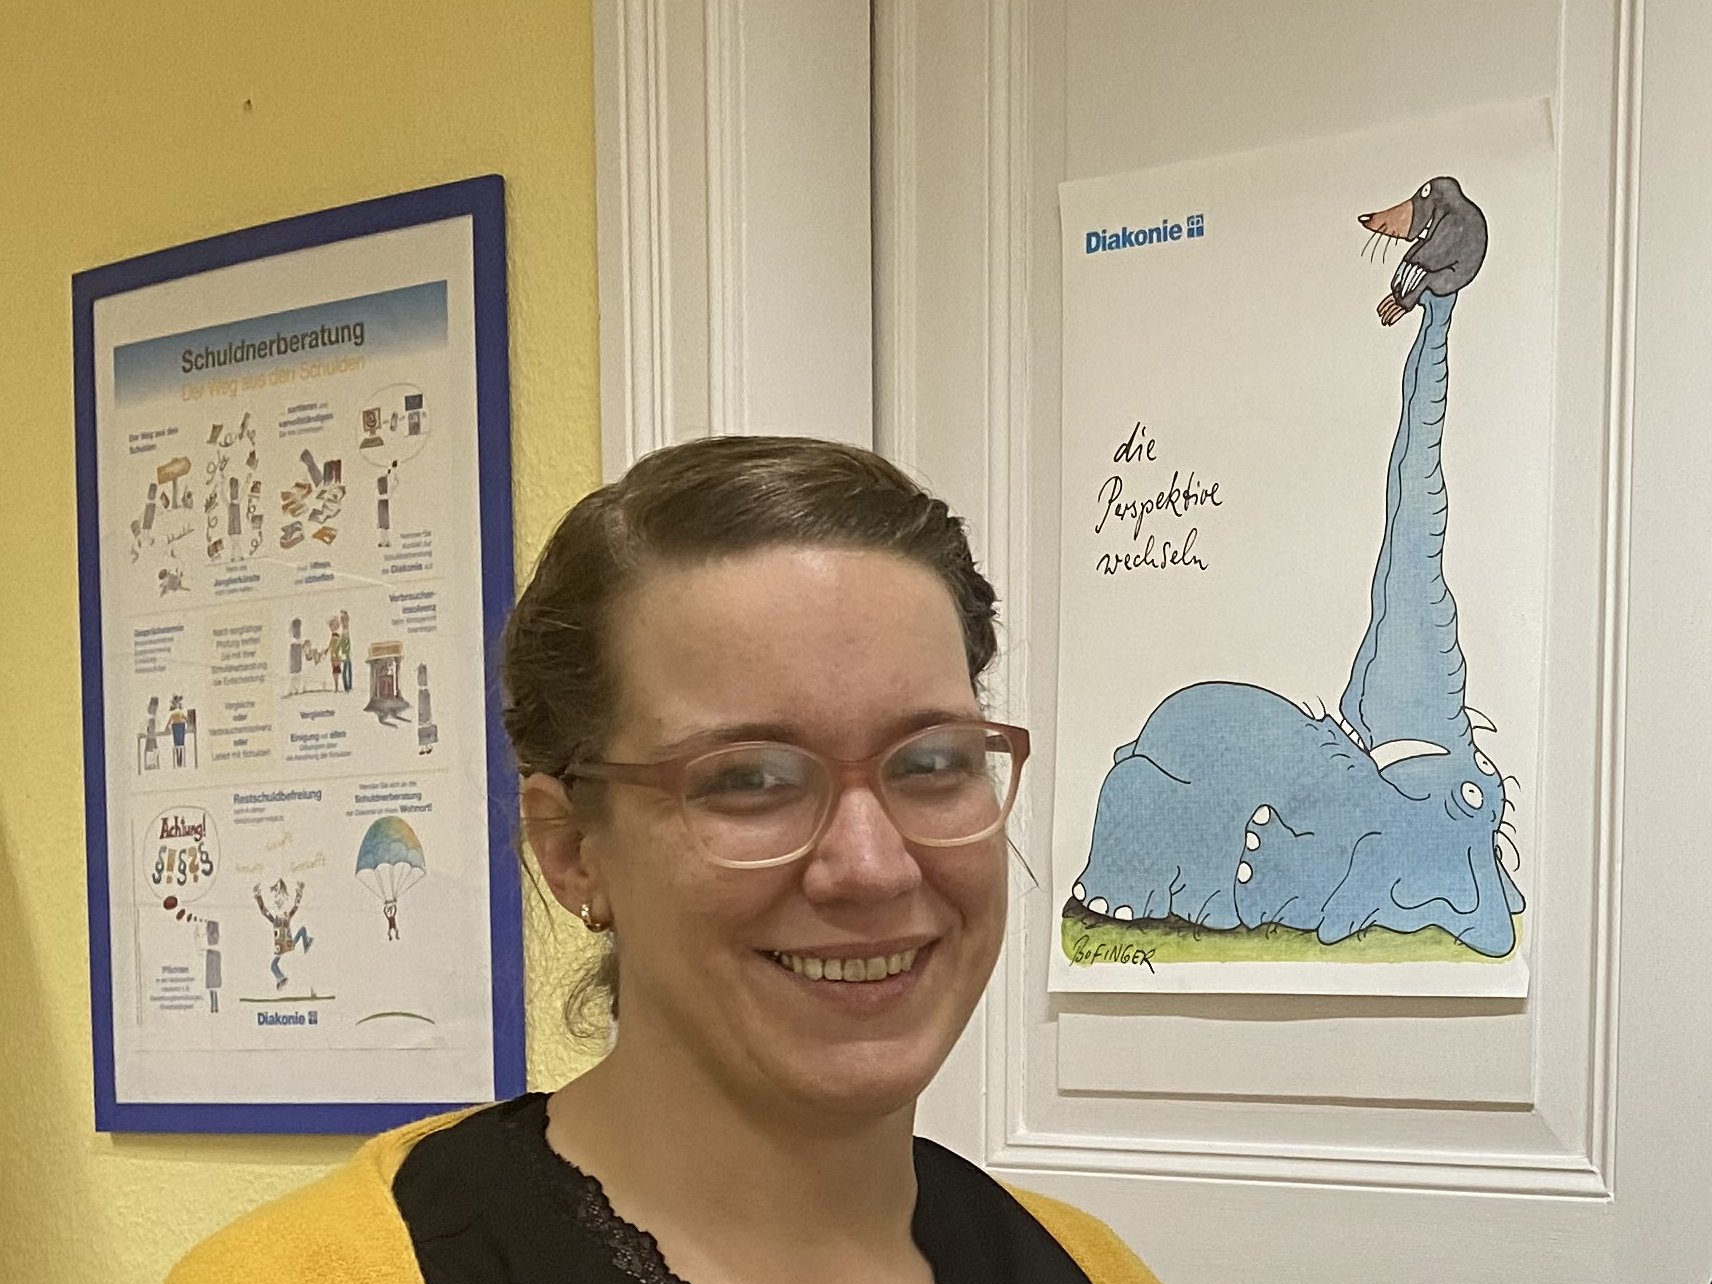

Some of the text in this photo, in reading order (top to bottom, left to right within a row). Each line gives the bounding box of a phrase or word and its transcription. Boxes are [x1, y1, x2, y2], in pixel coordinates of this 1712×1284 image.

[1086, 219, 1183, 254] Diakonie
[181, 321, 365, 373] Schuldnerberatung
[1113, 421, 1157, 463] die
[1095, 470, 1224, 541] Perspektive
[1096, 527, 1210, 575] wechseln
[159, 813, 207, 842] Achtung!
[257, 1011, 306, 1026] Diakonie
